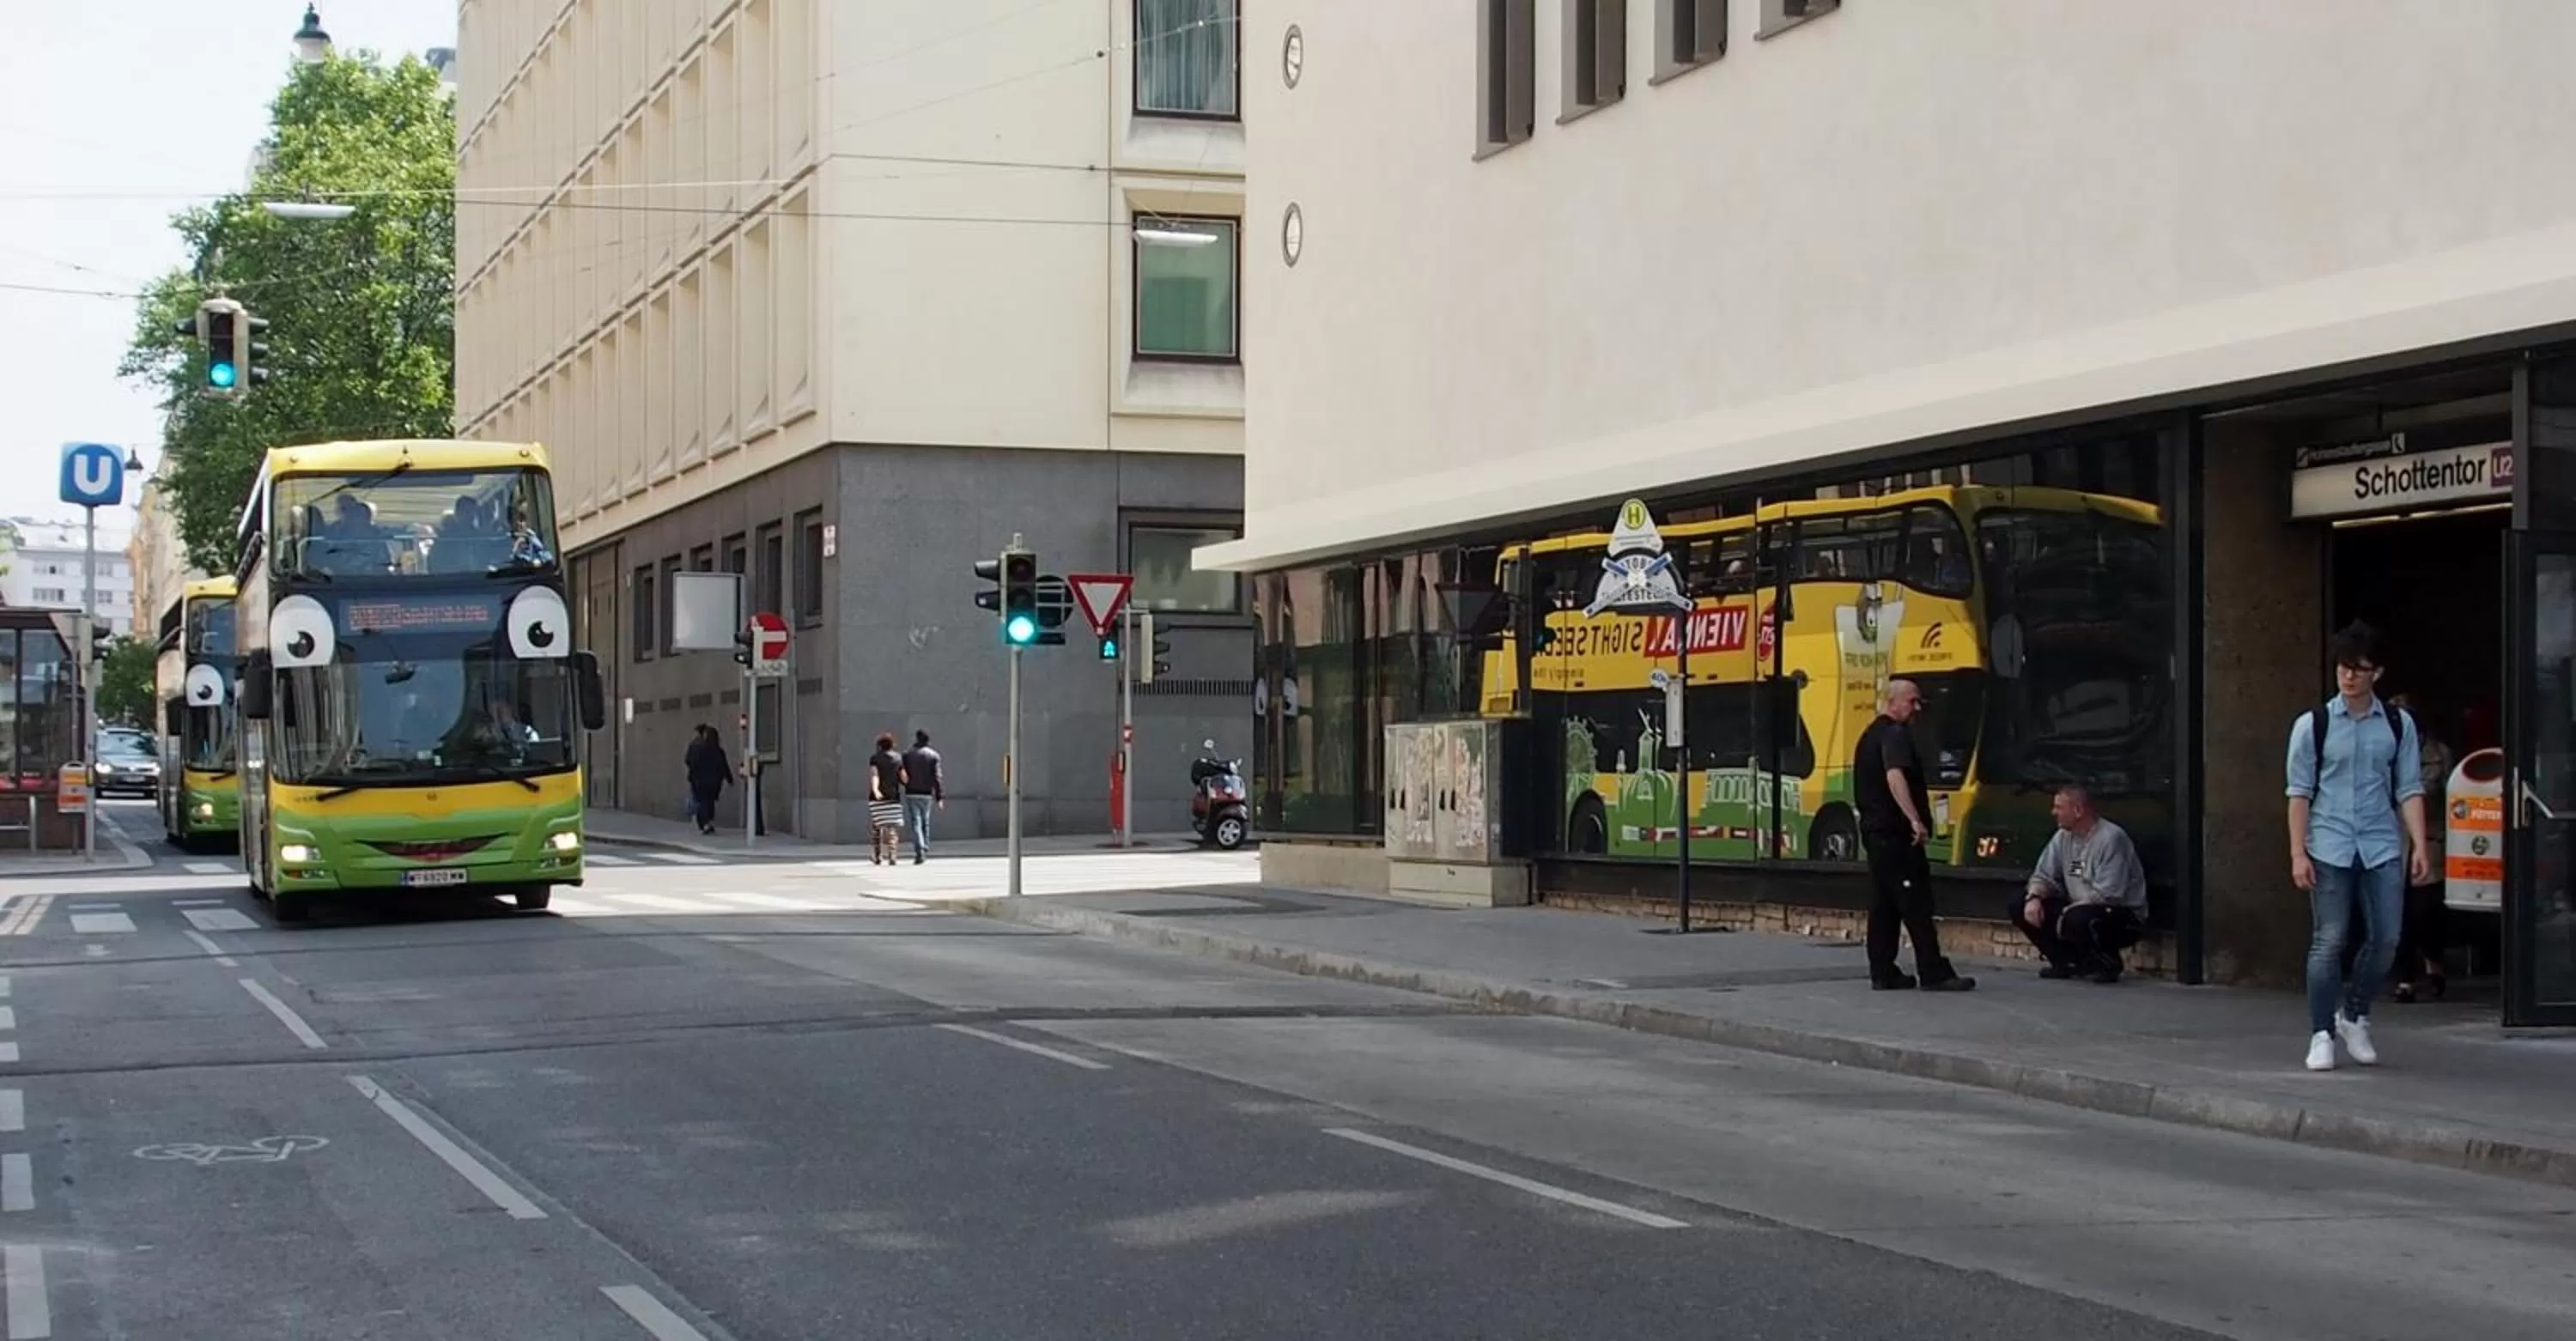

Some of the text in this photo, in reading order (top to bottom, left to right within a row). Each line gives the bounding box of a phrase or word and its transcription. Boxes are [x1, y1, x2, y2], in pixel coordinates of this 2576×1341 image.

[74, 453, 112, 495] U
[2354, 454, 2512, 499] Schottentor U2
[1627, 506, 1641, 525] H
